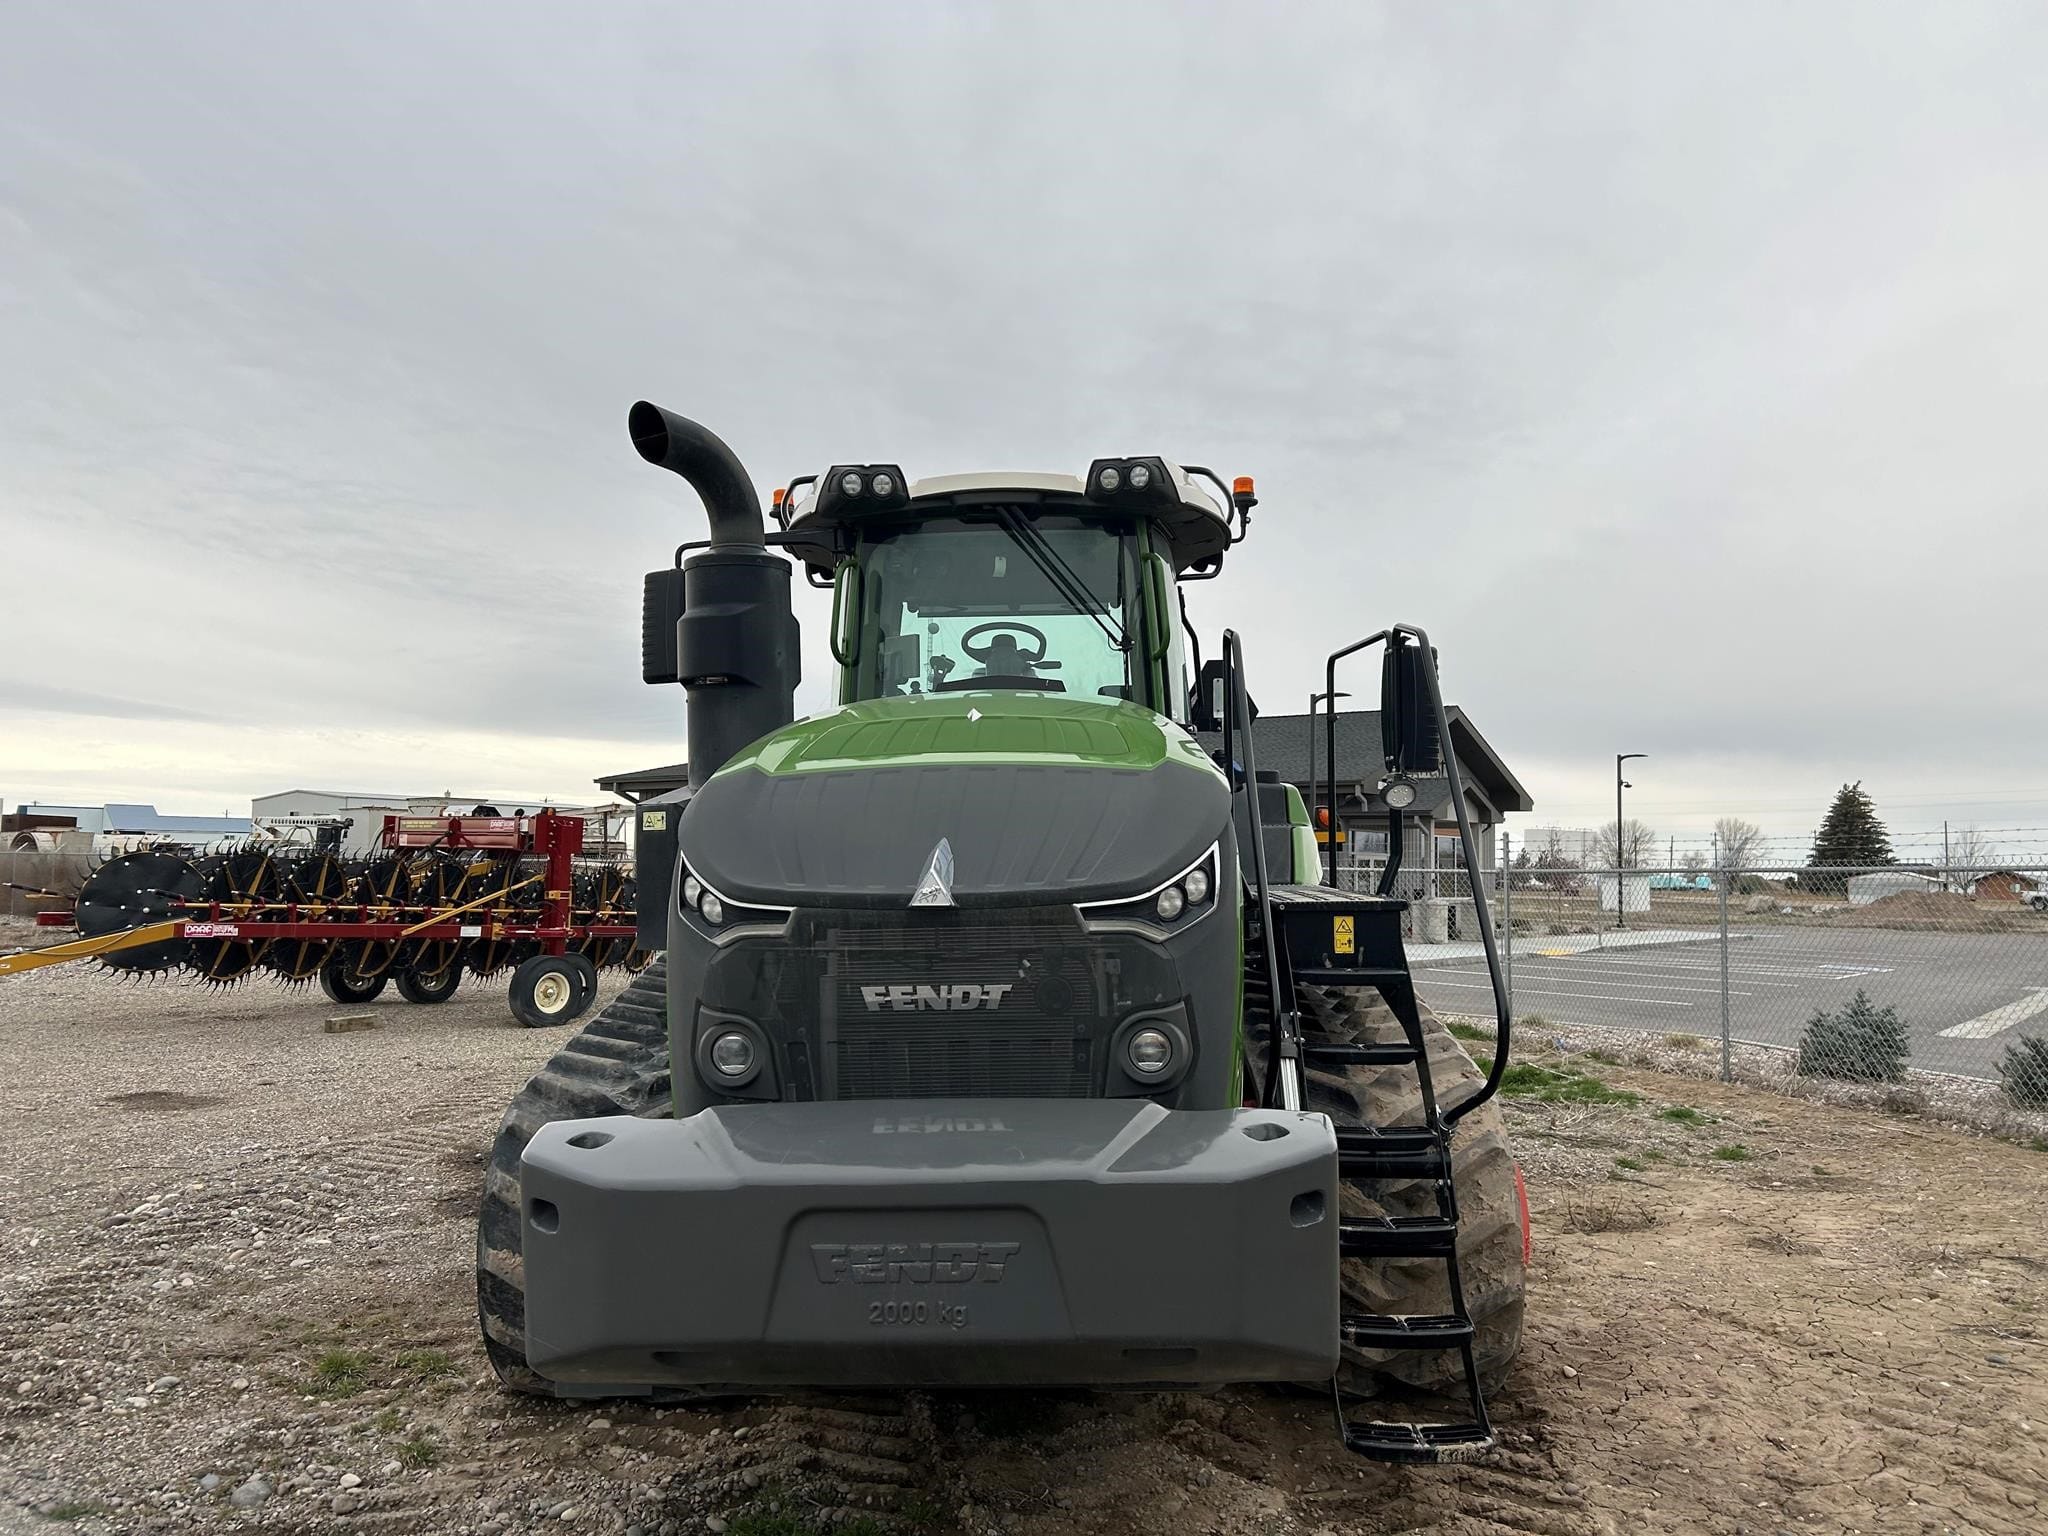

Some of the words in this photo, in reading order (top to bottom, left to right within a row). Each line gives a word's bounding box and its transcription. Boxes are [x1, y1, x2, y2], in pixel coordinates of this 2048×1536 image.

[860, 984, 1013, 1012] FENDT
[810, 1242, 1021, 1284] FENDT
[868, 1301, 929, 1324] 2000
[937, 1301, 968, 1328] kg
